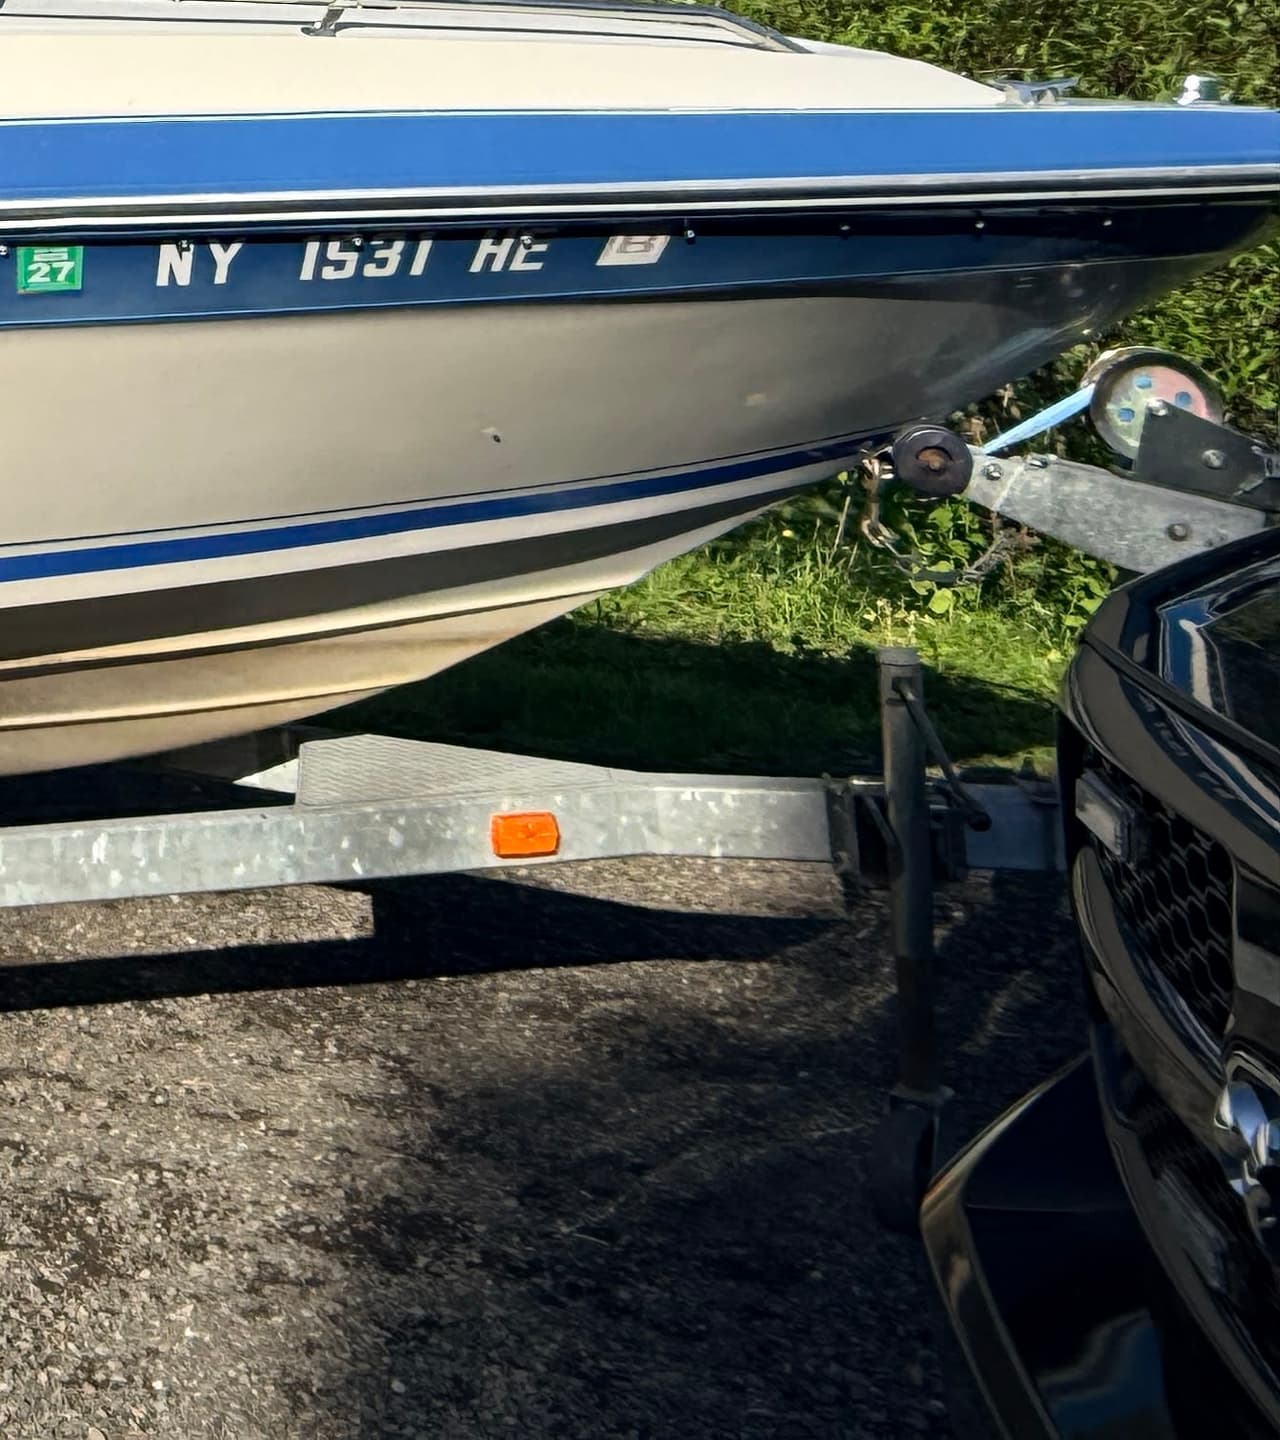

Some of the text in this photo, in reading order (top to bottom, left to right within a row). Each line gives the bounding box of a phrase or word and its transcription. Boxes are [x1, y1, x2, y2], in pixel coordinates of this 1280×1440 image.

[27, 261, 75, 283] 27
[156, 232, 549, 287] NY 1531 HE
